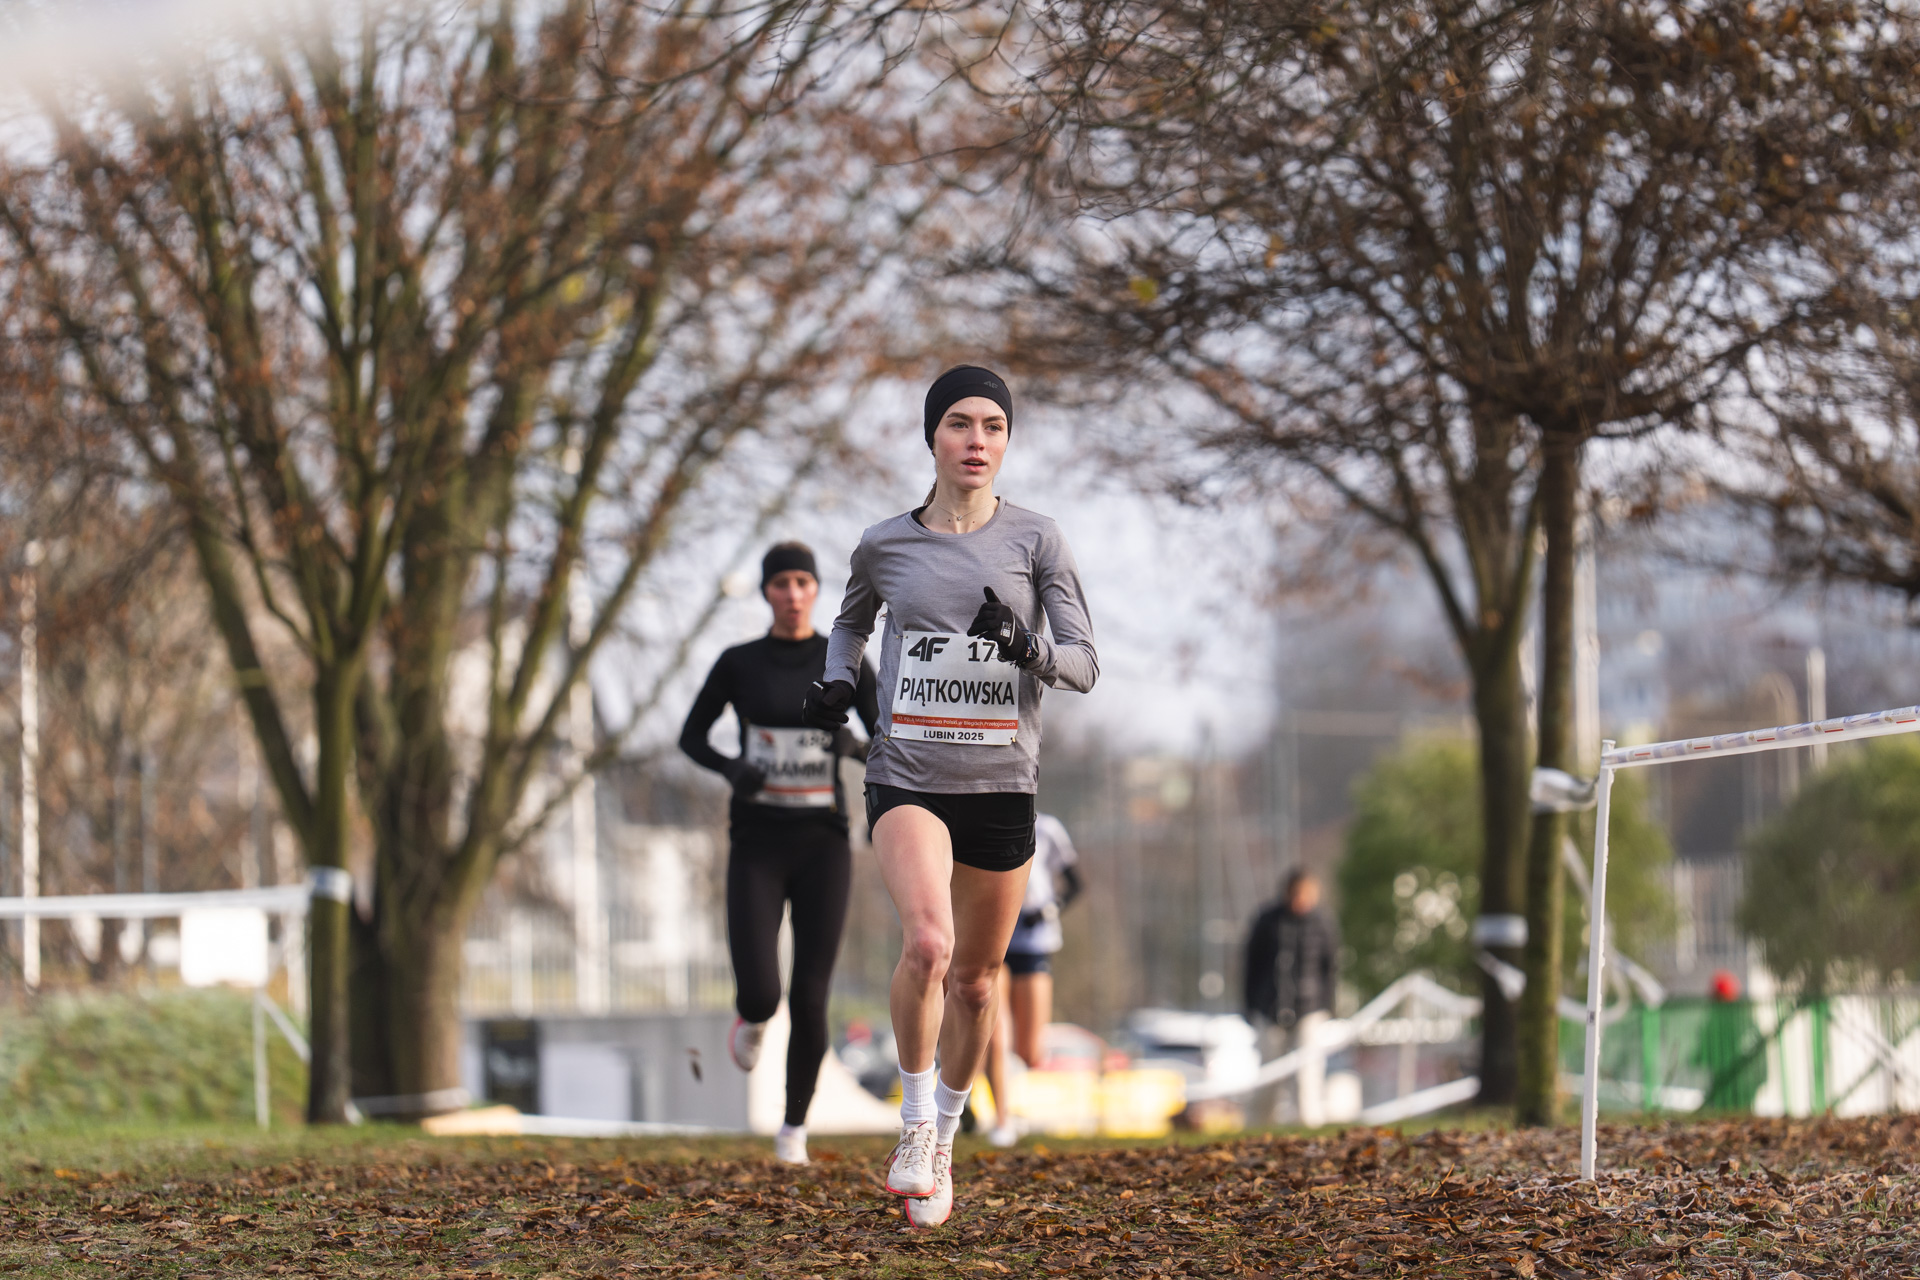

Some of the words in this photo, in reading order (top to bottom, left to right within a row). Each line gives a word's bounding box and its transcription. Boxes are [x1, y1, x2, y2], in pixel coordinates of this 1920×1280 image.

[908, 636, 950, 662] 4F
[968, 641, 1007, 662] 17
[900, 677, 1015, 706] PIĄTKOWSKA
[923, 730, 955, 740] LUBIN
[957, 732, 984, 741] 2025
